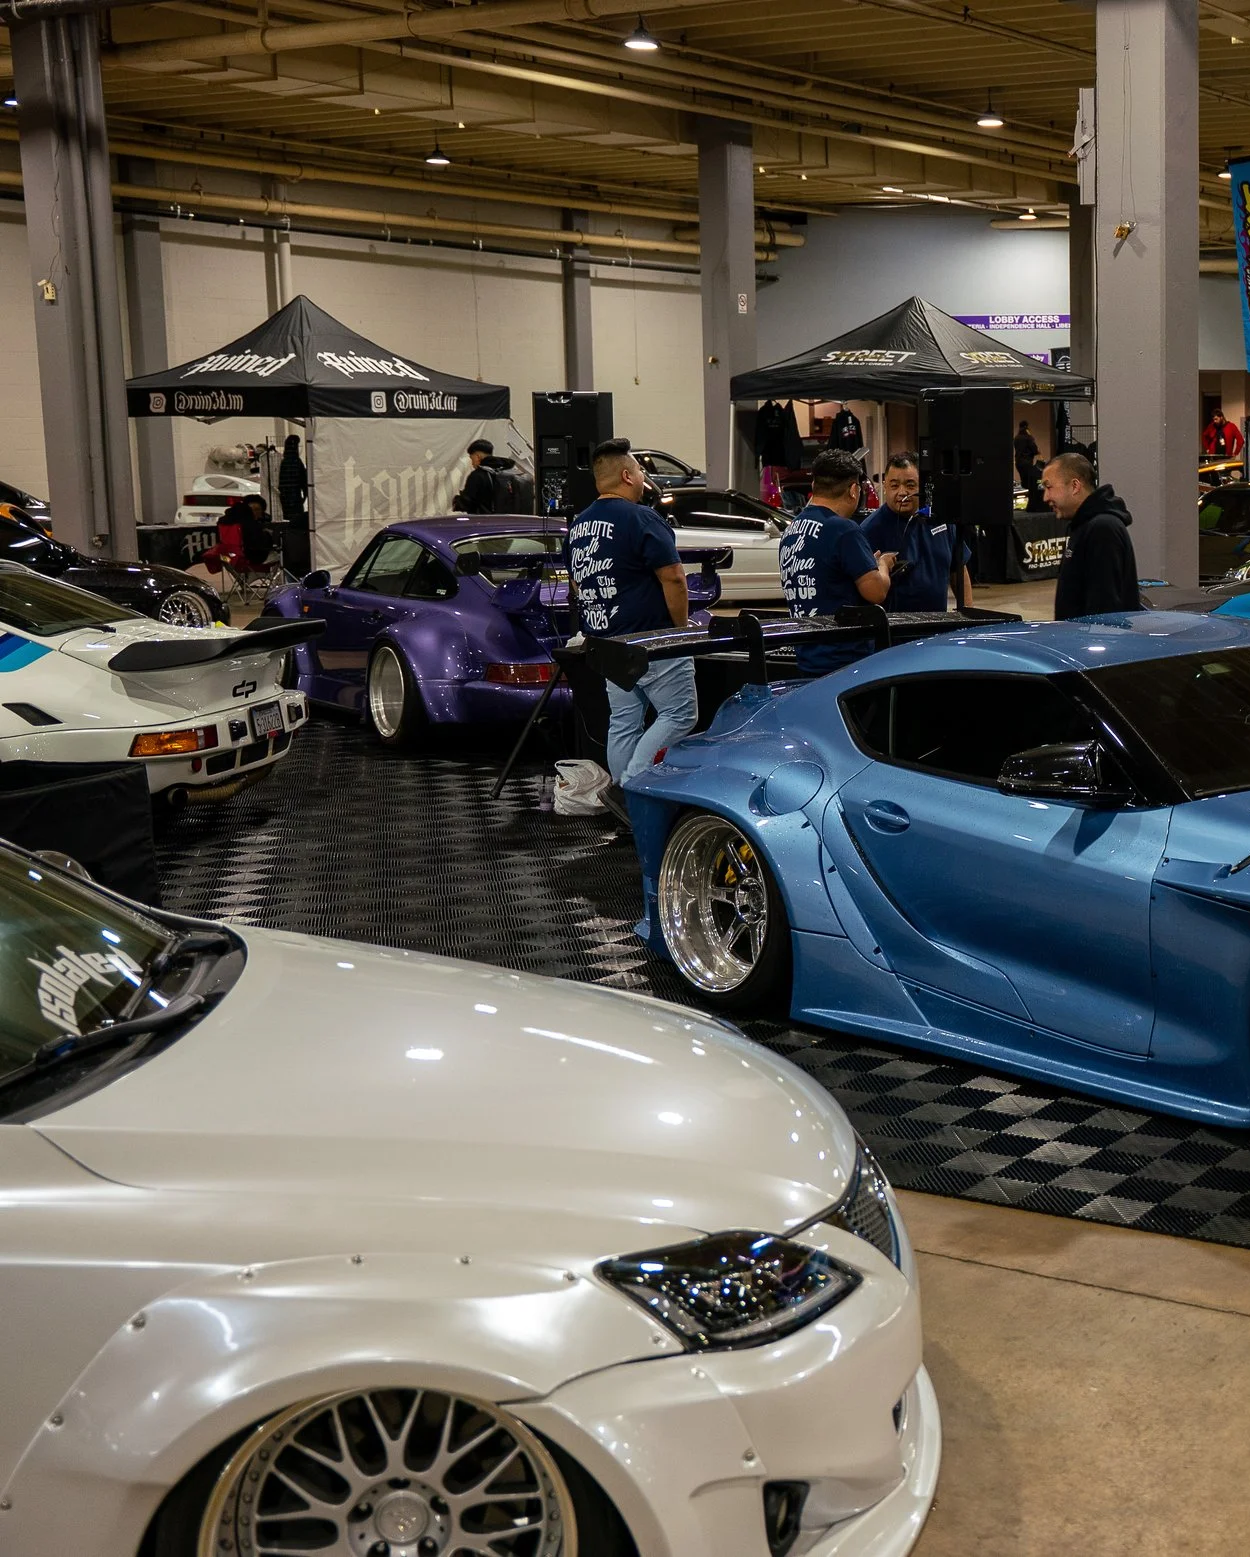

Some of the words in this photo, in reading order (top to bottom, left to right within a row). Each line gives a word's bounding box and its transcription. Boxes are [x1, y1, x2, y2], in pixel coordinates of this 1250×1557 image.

[989, 316, 1020, 324] LOBBY
[1022, 316, 1060, 324] ACCESS
[821, 349, 917, 363] STREET
[569, 520, 614, 544] CHARLOTTE
[596, 575, 615, 587] The
[797, 574, 816, 587] The
[600, 586, 617, 599] UP
[798, 587, 817, 600] UP
[584, 609, 609, 631] 2025
